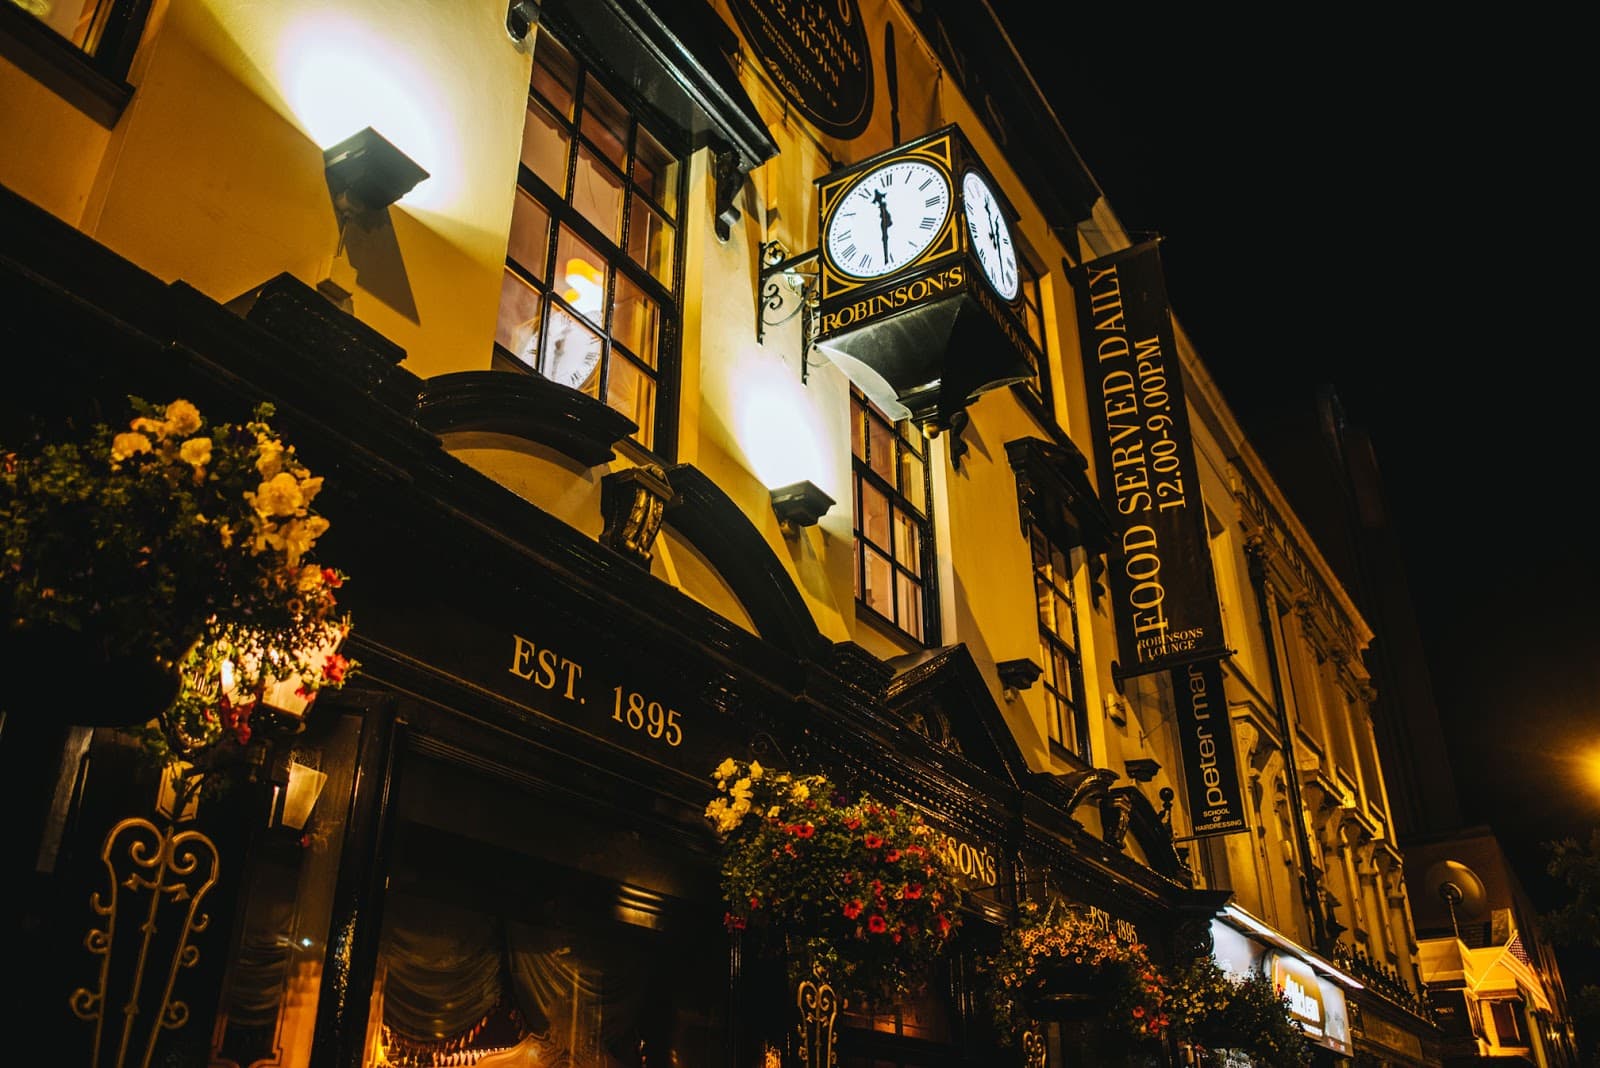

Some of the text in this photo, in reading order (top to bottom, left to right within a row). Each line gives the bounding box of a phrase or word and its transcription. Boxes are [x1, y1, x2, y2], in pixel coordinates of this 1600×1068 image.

[821, 266, 963, 334] ROBINSON'S
[1086, 263, 1169, 637] FOOD SERVED DAILY
[1147, 639, 1196, 657] LOUNGE
[508, 633, 683, 747] EST. 1895
[1195, 726, 1228, 807] peter
[1203, 808, 1231, 818] SCHOOL
[1117, 918, 1138, 945] 1895
